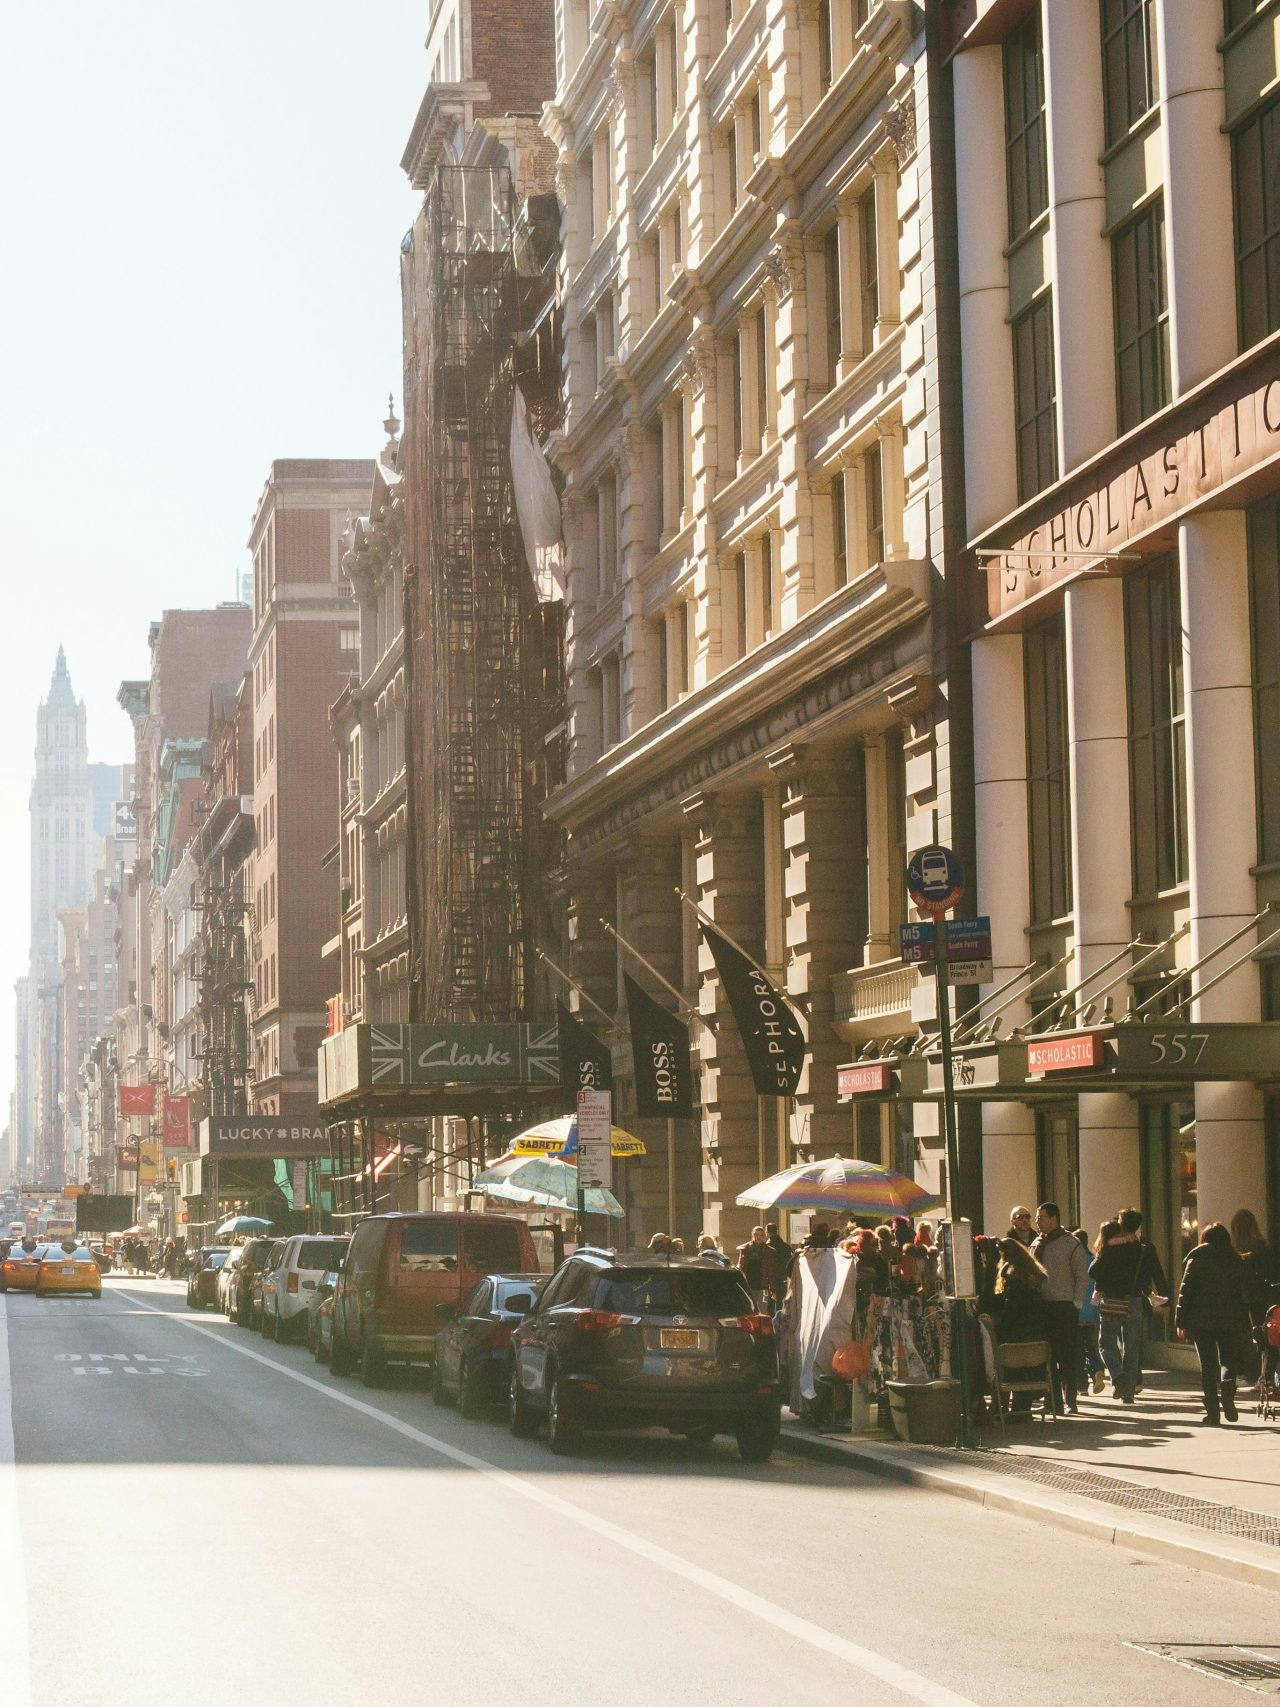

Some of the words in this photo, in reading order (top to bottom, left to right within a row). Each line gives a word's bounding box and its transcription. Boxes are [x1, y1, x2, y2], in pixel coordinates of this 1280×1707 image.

[902, 925, 920, 941] M5
[903, 945, 921, 961] M5
[950, 962, 977, 971] Broadway
[748, 970, 788, 1088] SEPHORA
[417, 1040, 512, 1068] Clarks
[1036, 1043, 1092, 1065] SCHOLASTIC
[1150, 1034, 1210, 1065] 557
[652, 1042, 673, 1102] BOSS
[844, 1071, 881, 1087] SCHOLASTIC
[579, 1093, 585, 1103] 3
[219, 1128, 274, 1140] LUCKY
[519, 1140, 565, 1151] SABRETT
[579, 1146, 585, 1155] 2
[54, 1353, 199, 1363] ONLY
[72, 1366, 209, 1375] BUS
